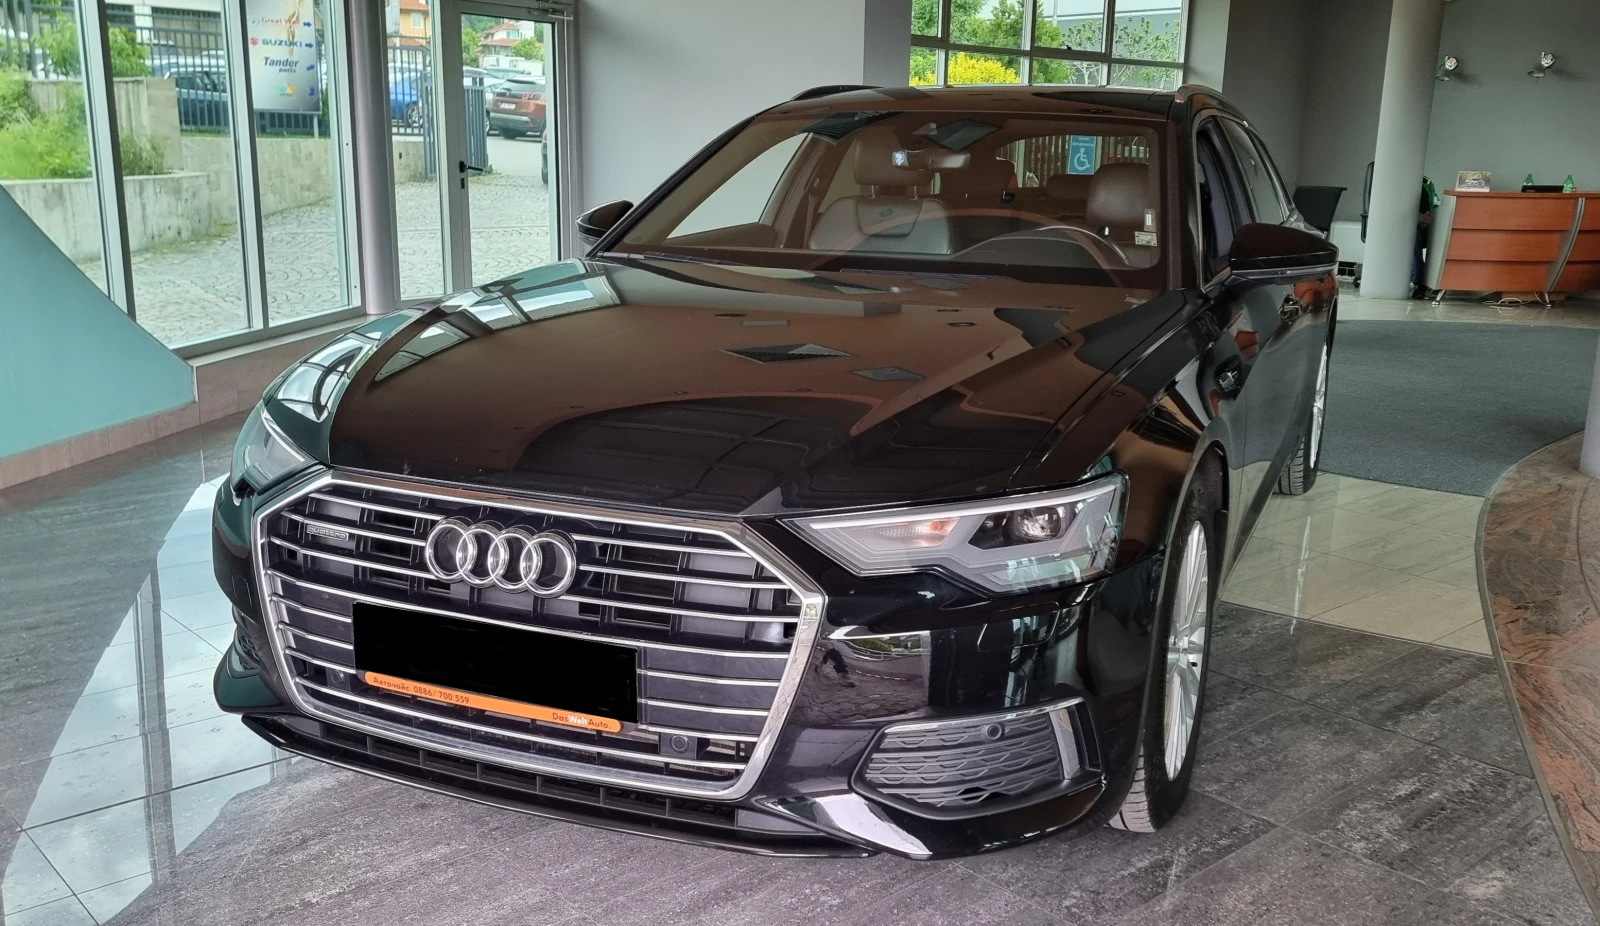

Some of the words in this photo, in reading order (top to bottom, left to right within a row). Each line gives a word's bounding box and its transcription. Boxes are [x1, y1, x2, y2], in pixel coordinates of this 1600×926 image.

[262, 38, 302, 48] SUZUKI
[264, 56, 299, 68] Tander
[439, 691, 453, 701] 700
[455, 695, 470, 704] 559
